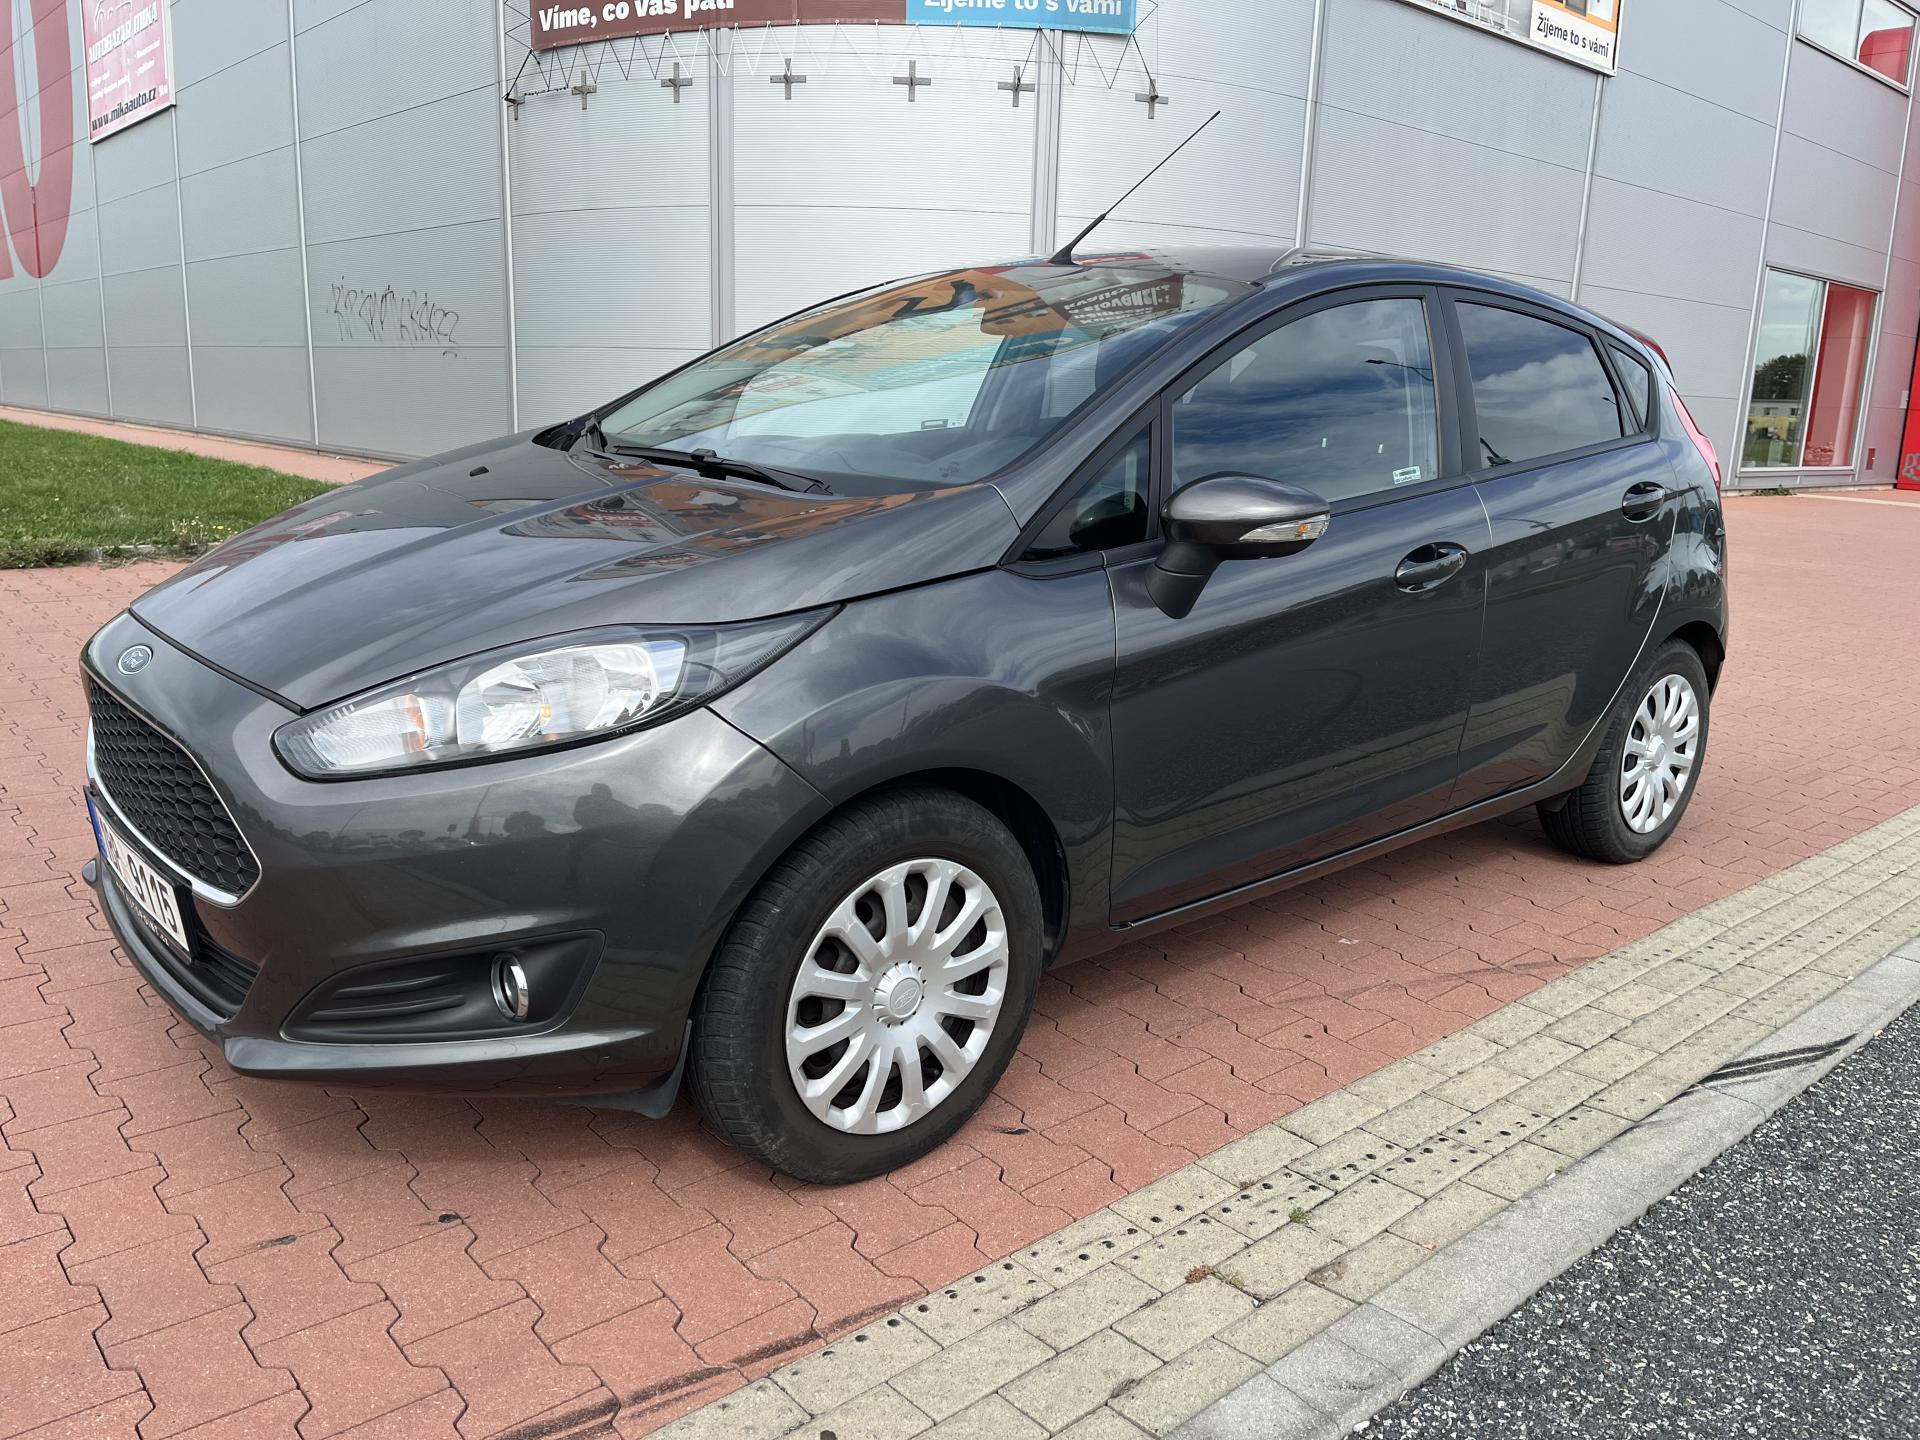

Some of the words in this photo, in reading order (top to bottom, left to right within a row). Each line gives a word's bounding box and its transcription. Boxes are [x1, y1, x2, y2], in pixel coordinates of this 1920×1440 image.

[538, 5, 597, 32] Víme,
[602, 2, 630, 22] co
[1537, 12, 1568, 41] Žijeme
[1570, 30, 1580, 46] to
[1581, 36, 1588, 49] s
[1588, 38, 1610, 58] vámi
[91, 87, 156, 131] www.mikaauto.cz
[127, 853, 178, 934] 9115
